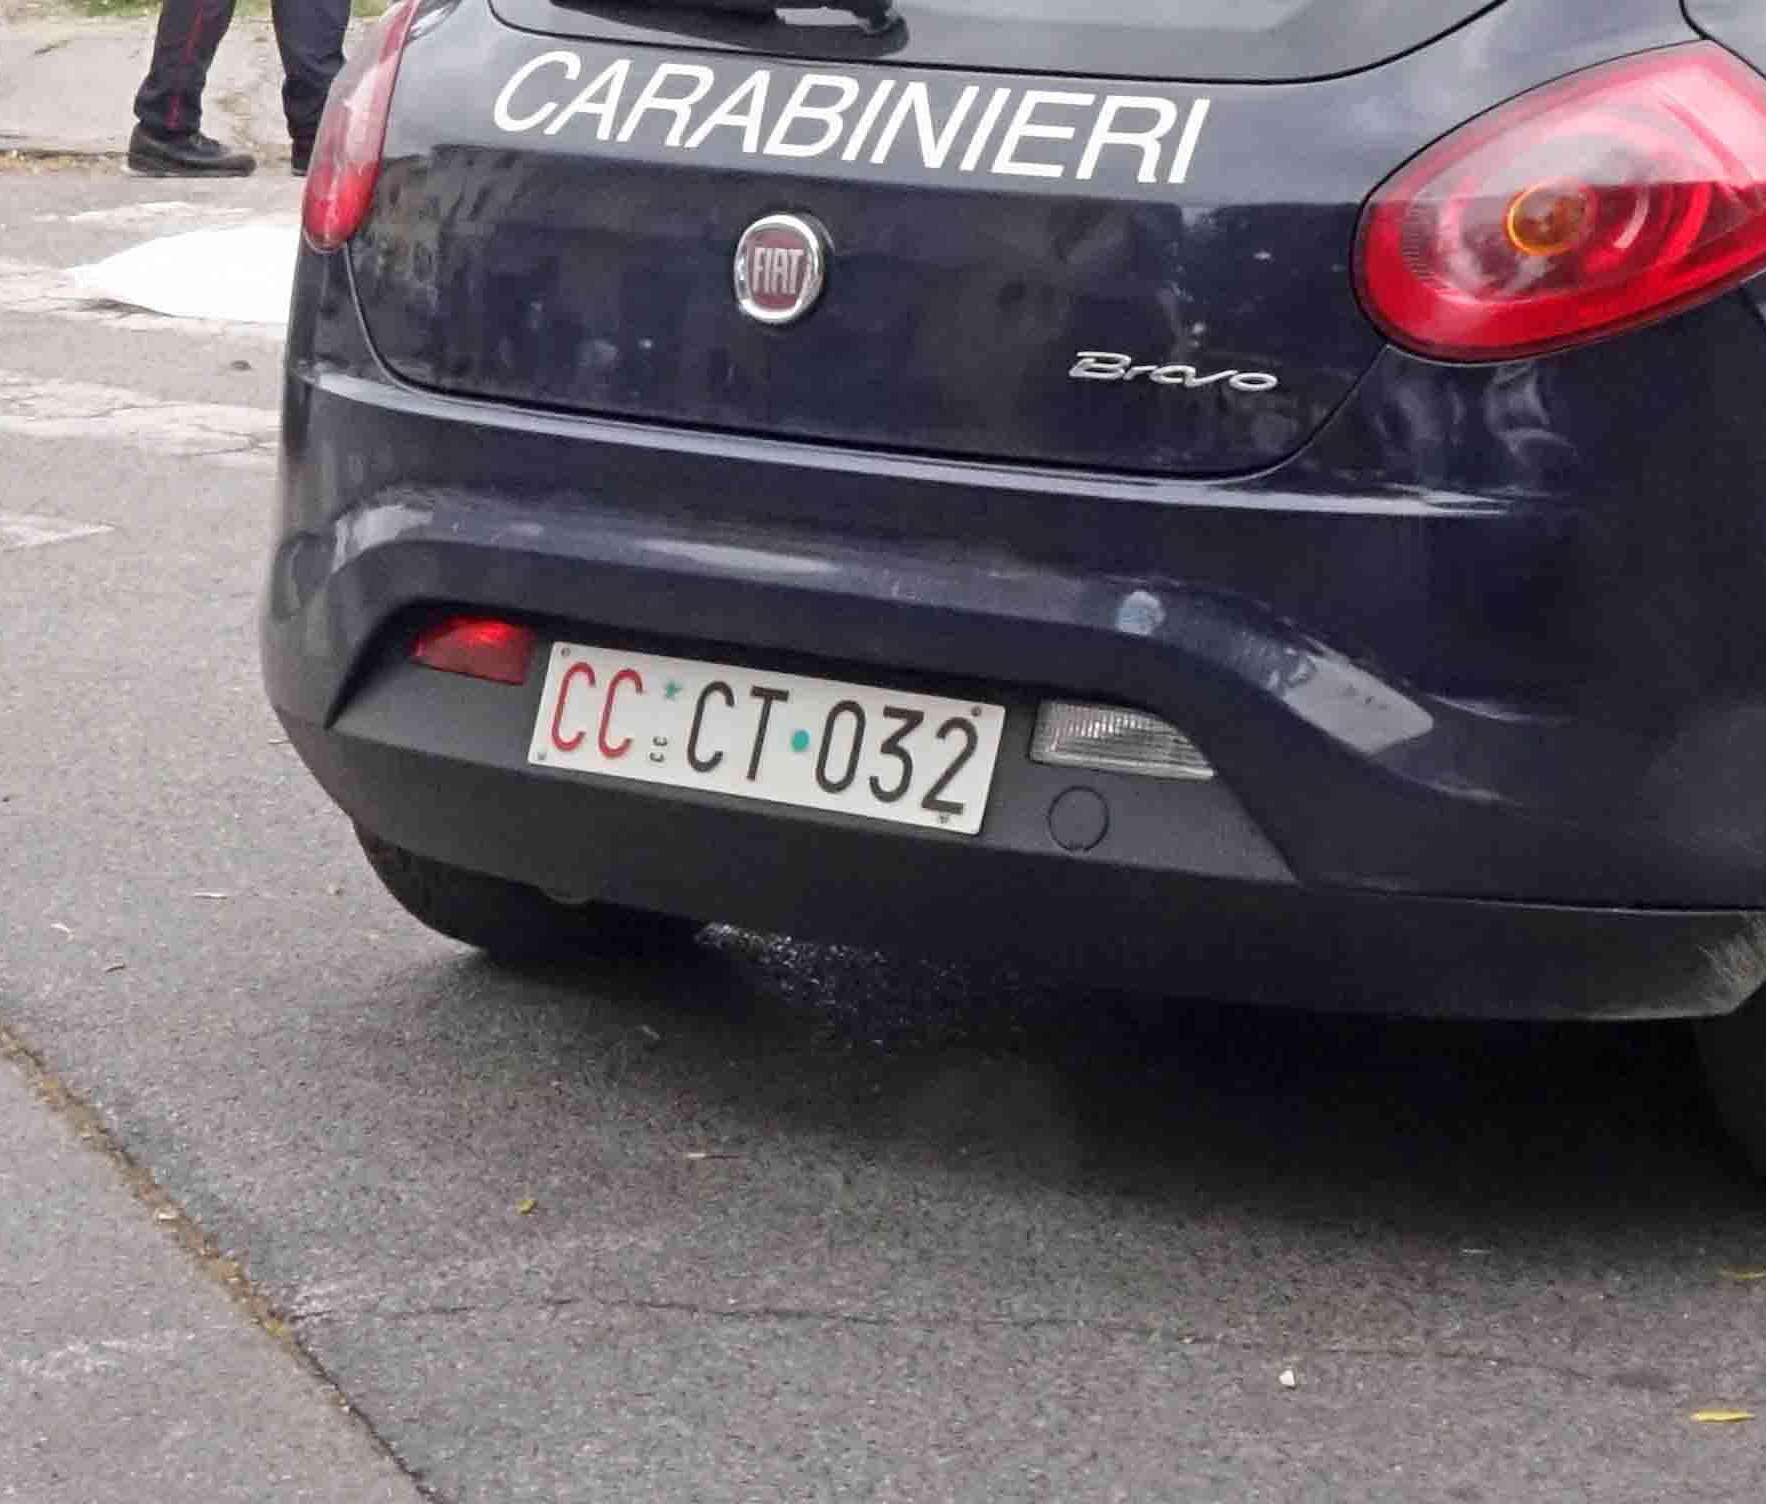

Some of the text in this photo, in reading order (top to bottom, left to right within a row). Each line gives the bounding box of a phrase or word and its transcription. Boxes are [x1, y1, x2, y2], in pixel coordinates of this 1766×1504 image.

[492, 50, 1210, 185] CARABINIERI
[752, 246, 804, 295] FIAT
[1068, 350, 1278, 392] Bravo
[551, 661, 979, 816] CC CT 032
